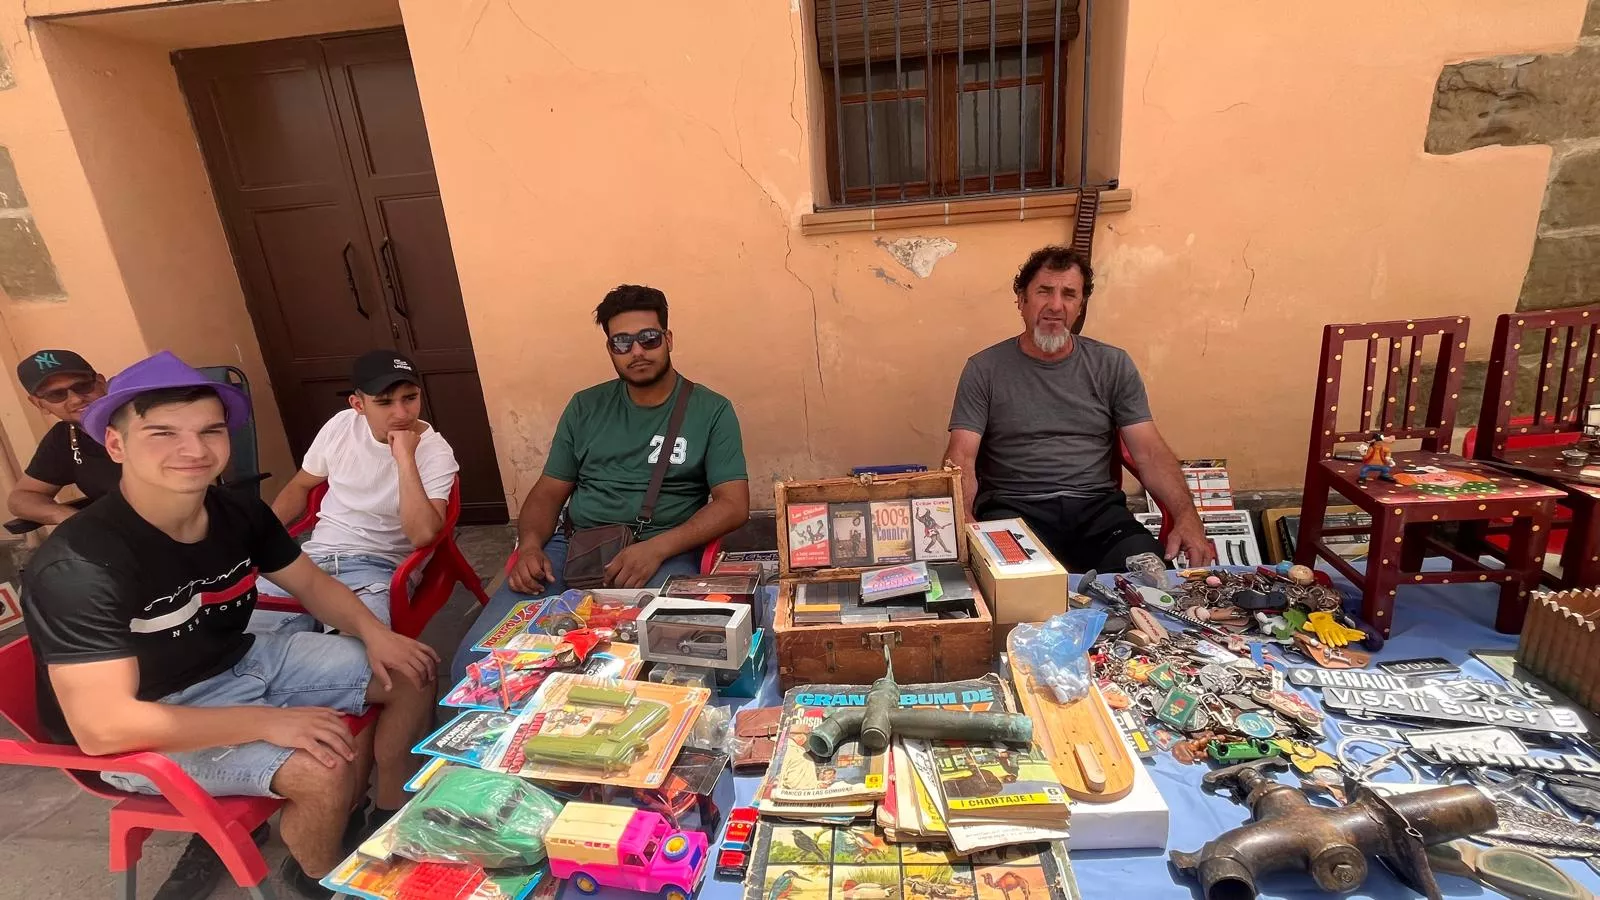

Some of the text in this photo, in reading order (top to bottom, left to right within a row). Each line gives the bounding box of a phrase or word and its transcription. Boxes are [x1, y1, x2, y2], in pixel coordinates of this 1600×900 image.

[647, 434, 688, 465] 23
[874, 507, 909, 527] 100%
[876, 526, 910, 541] Country
[1315, 670, 1409, 691] RENAULT
[795, 693, 866, 706] GRAN
[961, 687, 995, 703] DE
[1327, 688, 1405, 710] VISA
[1438, 699, 1540, 724] Super
[1548, 708, 1577, 727] E
[1351, 725, 1380, 736] GS
[1430, 740, 1565, 770] Ritmo
[967, 794, 1027, 807] CHANTAJE
